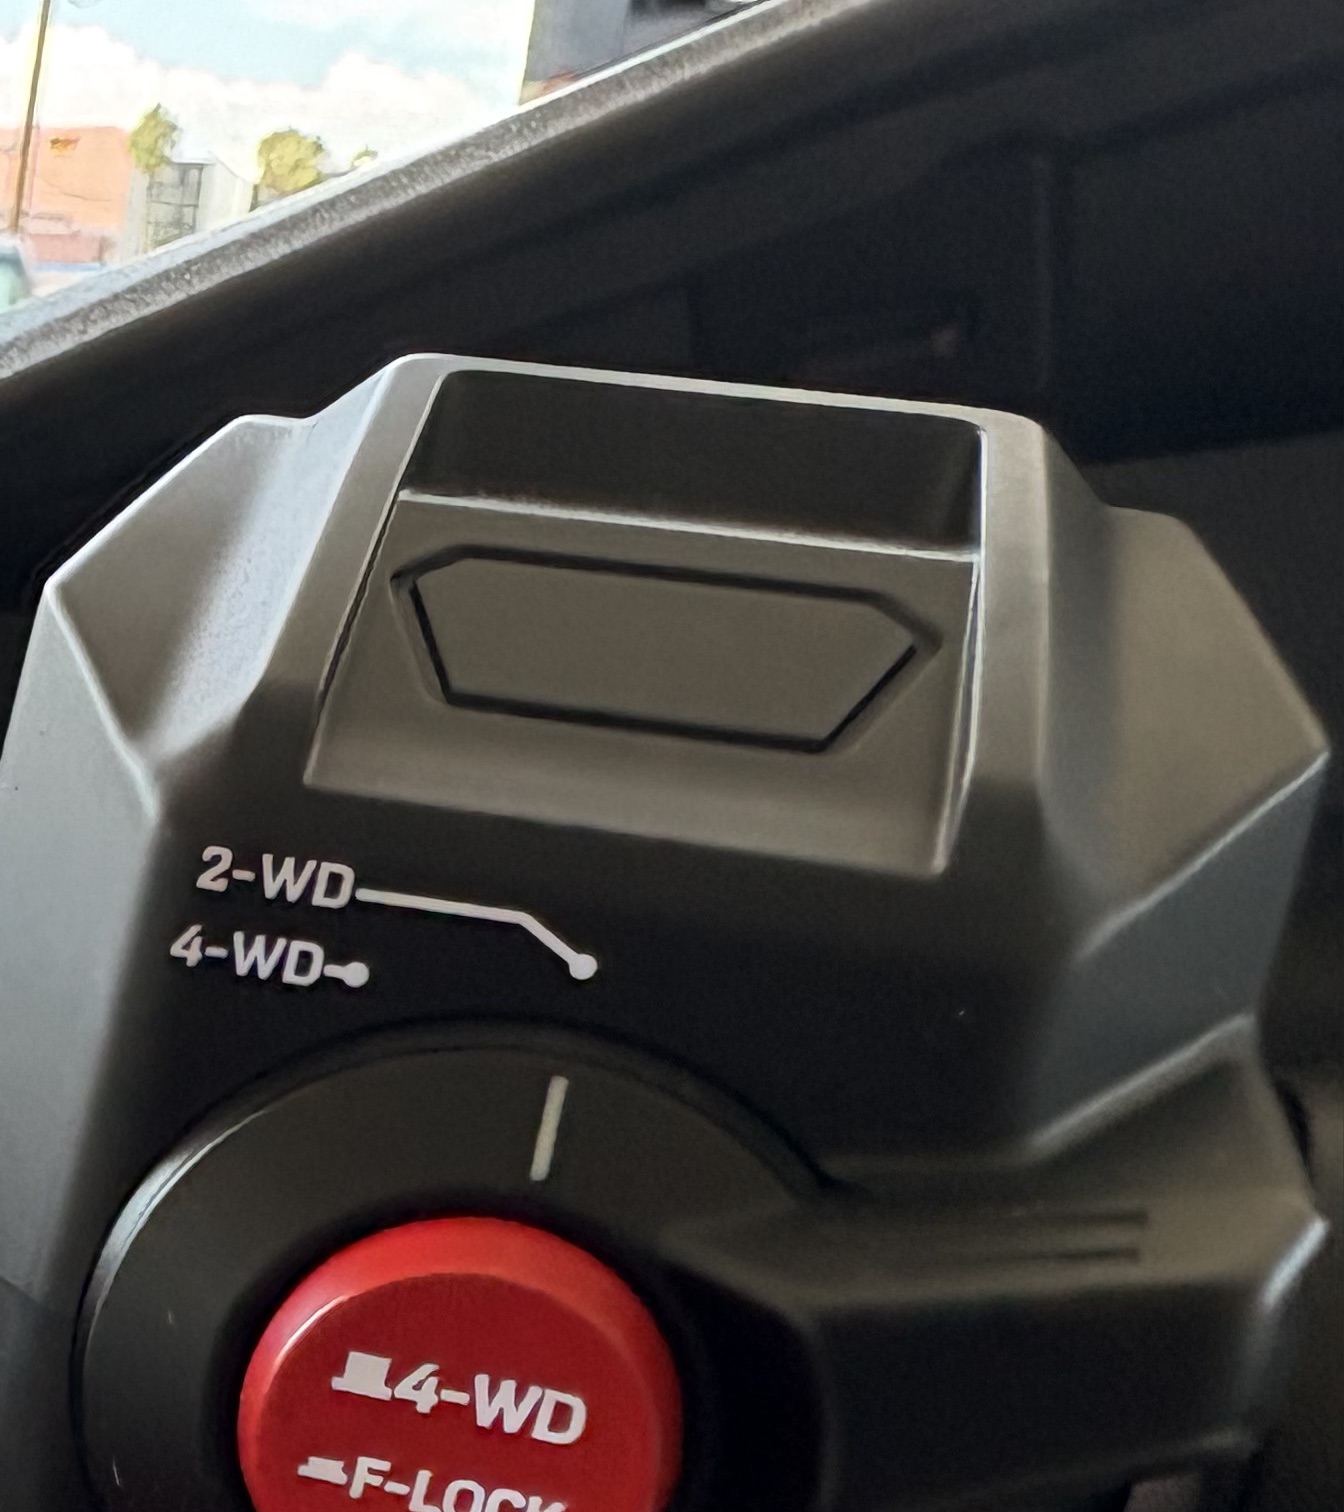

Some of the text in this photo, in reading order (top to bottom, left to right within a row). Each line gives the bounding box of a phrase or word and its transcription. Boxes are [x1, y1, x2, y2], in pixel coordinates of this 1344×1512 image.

[195, 845, 356, 909] 2-WD
[169, 923, 325, 987] 4-WD
[393, 1362, 588, 1446] 4-WD
